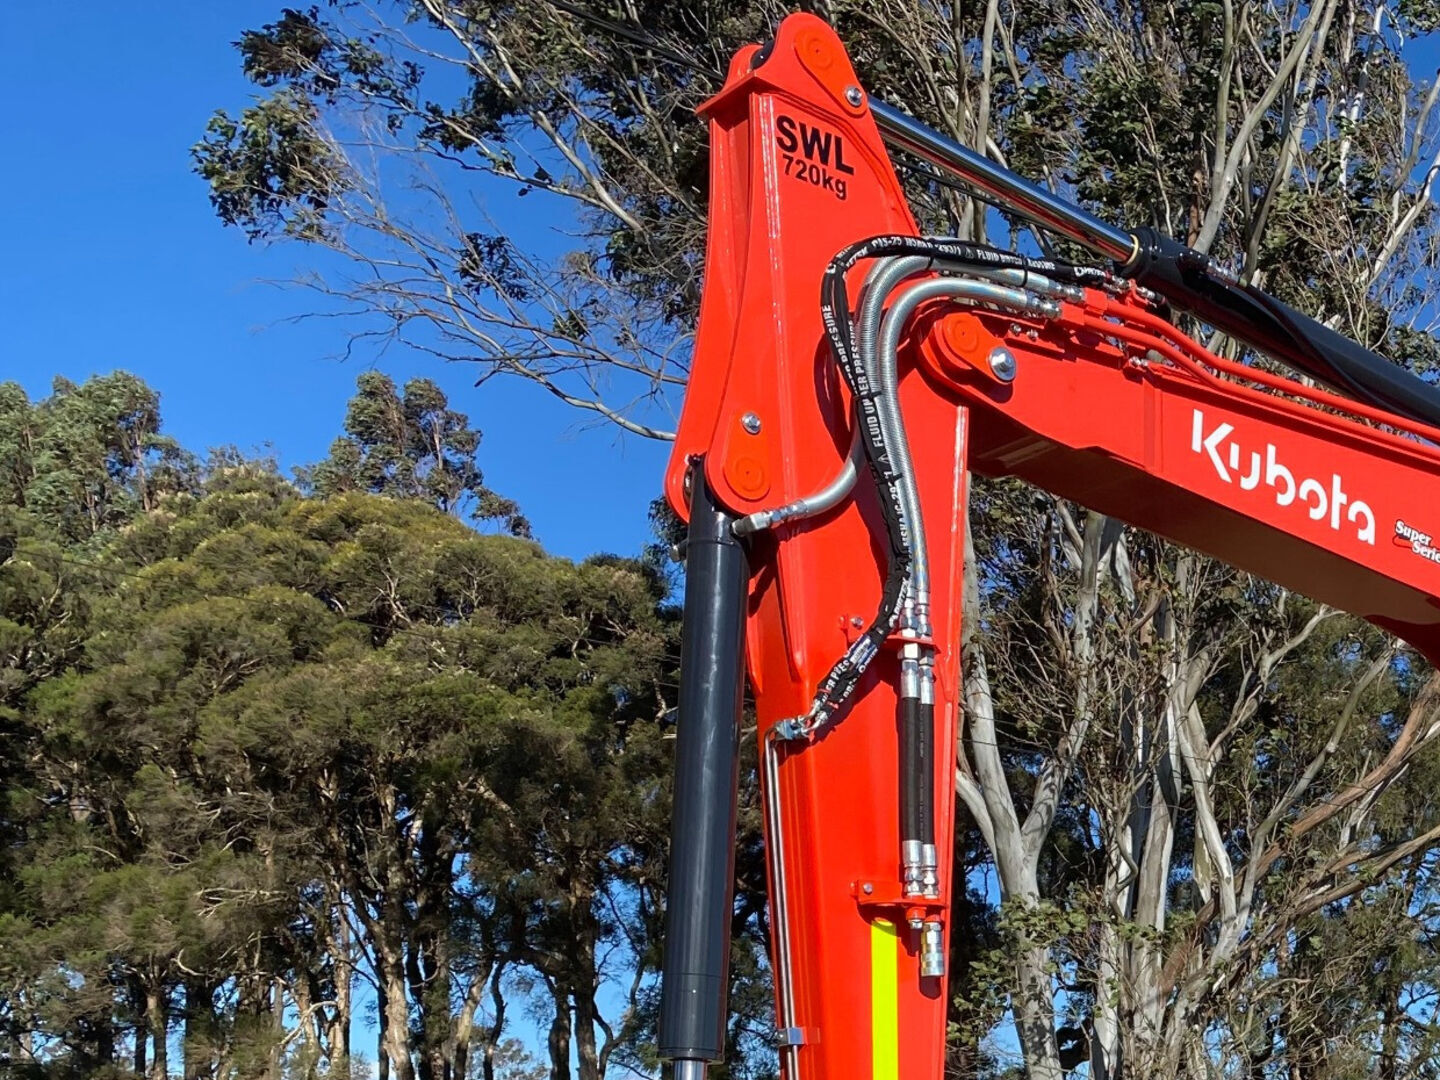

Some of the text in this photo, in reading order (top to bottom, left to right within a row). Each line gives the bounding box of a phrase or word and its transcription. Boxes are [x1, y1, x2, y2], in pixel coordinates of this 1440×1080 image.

[776, 115, 854, 175] SWL
[782, 154, 847, 200] 720kg
[867, 416, 884, 447] FLUID
[1191, 408, 1376, 546] Kubota
[1395, 520, 1432, 546] Super
